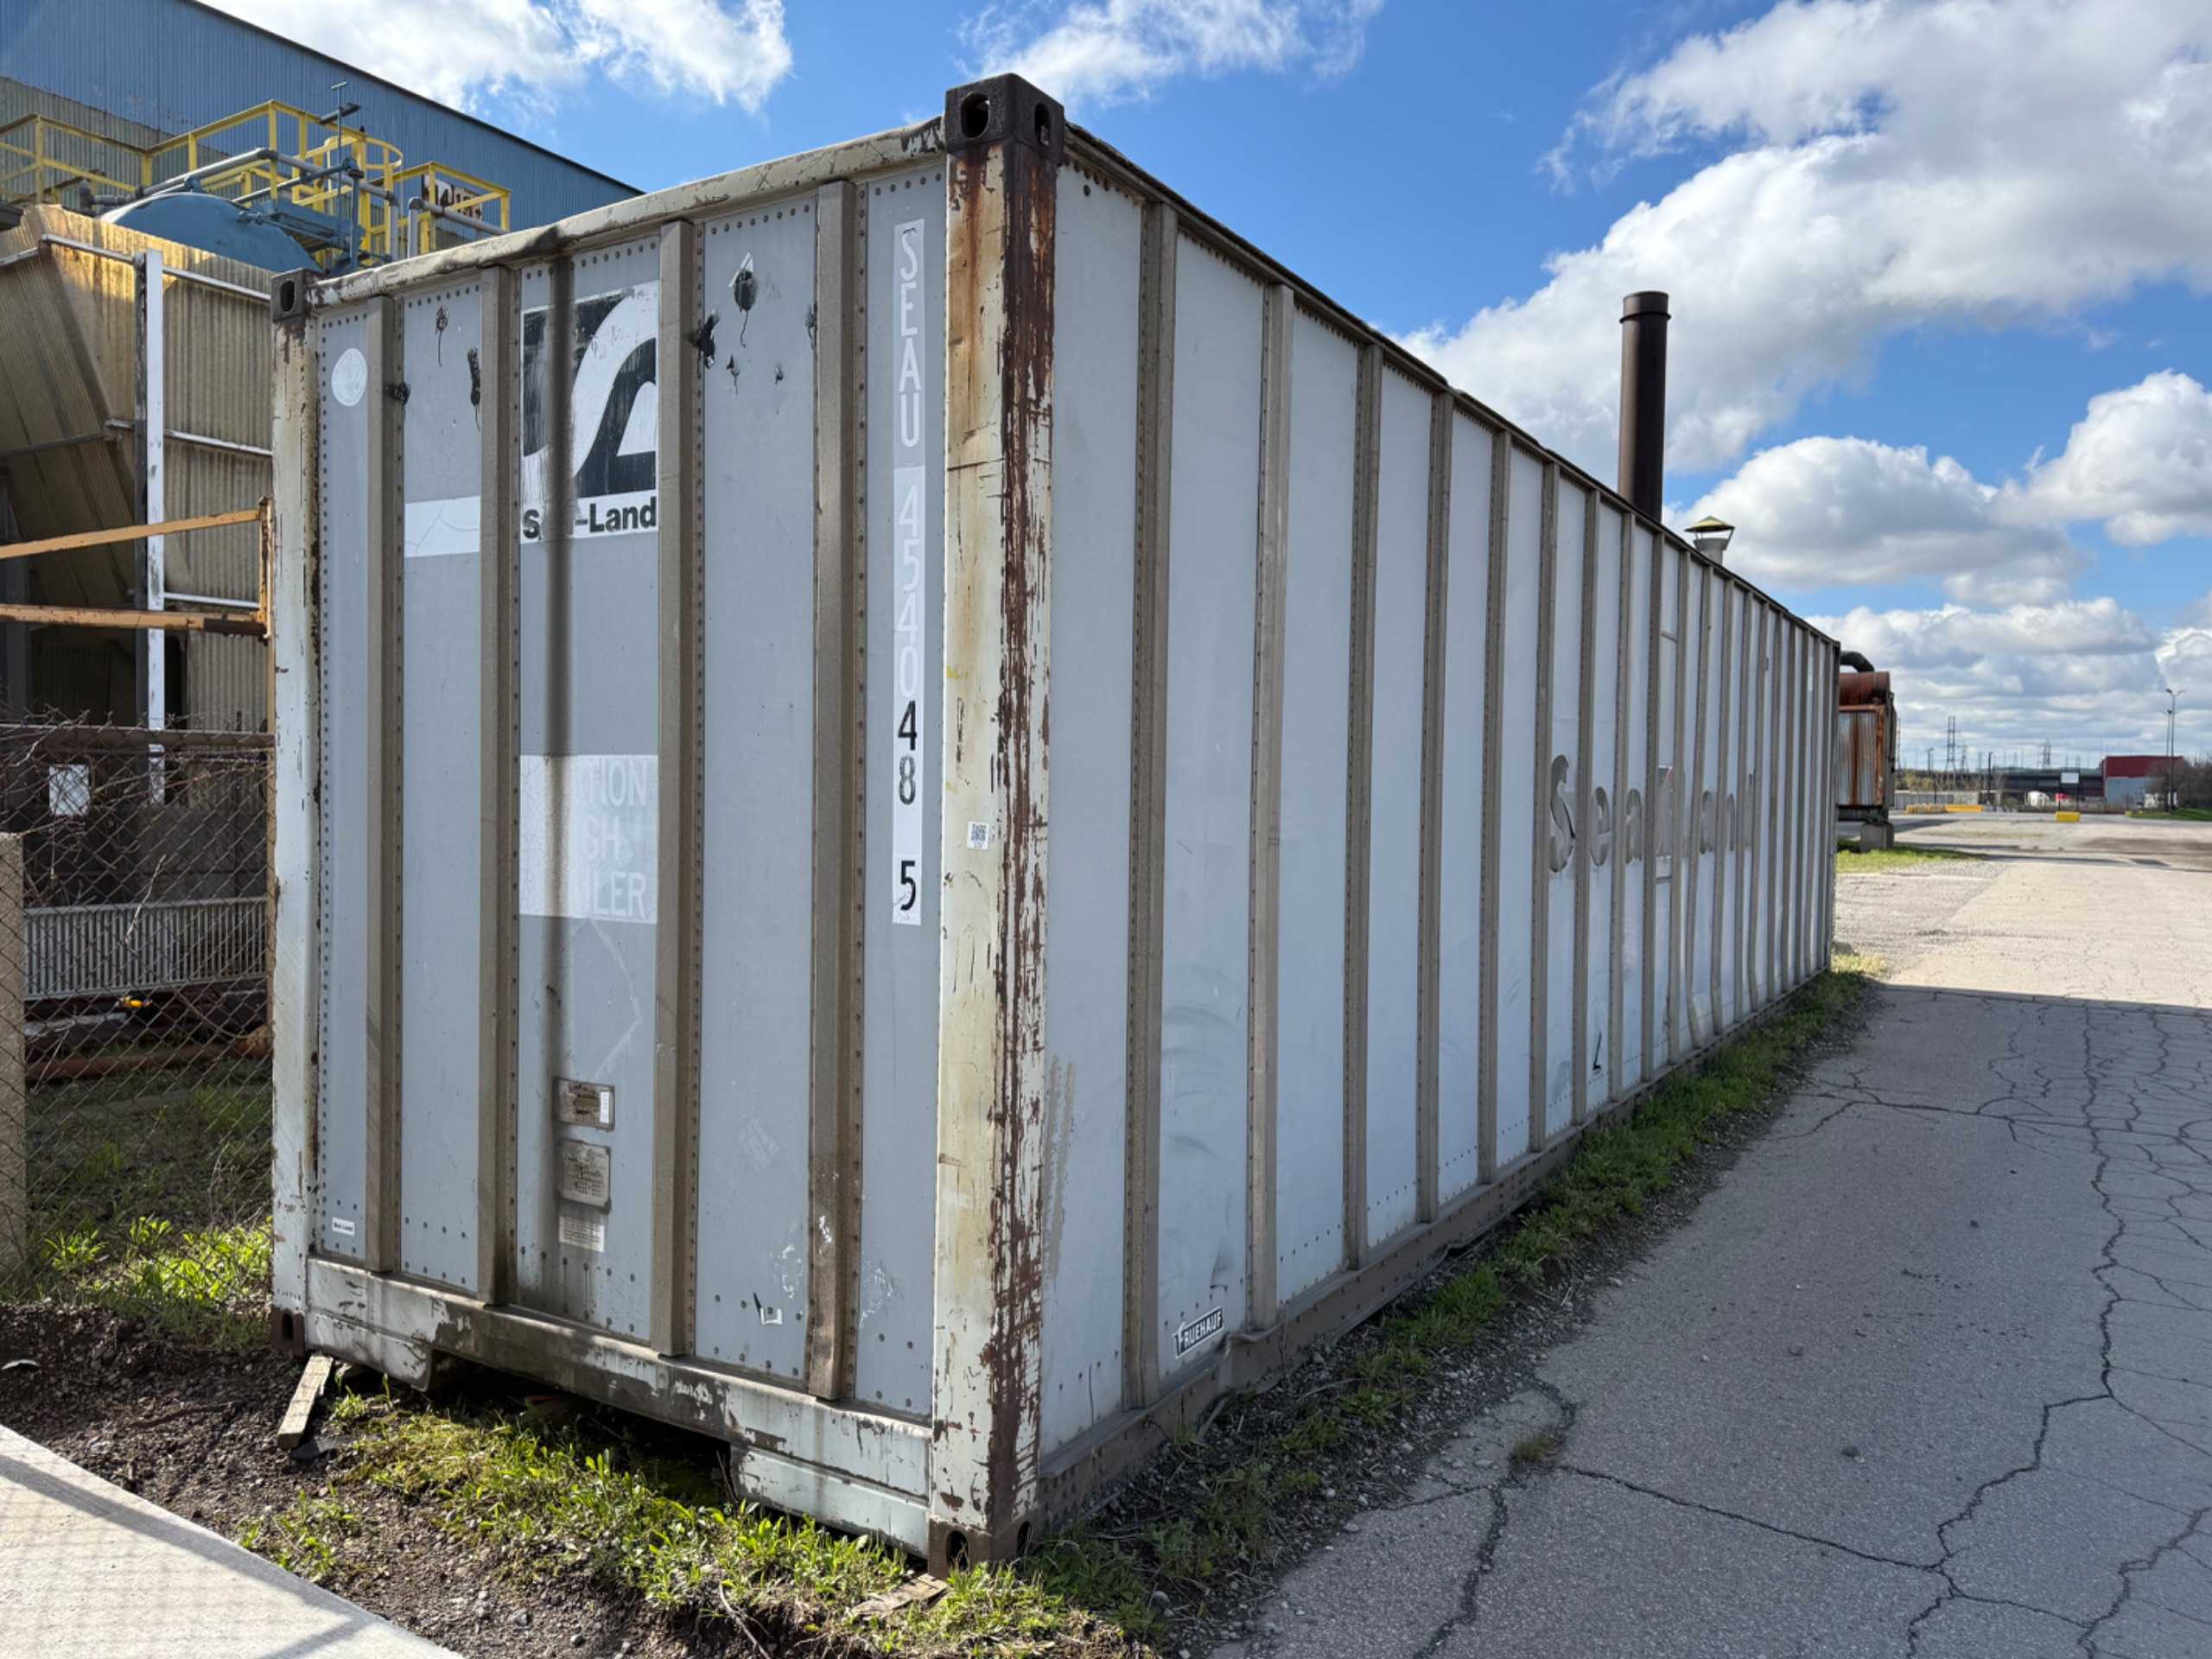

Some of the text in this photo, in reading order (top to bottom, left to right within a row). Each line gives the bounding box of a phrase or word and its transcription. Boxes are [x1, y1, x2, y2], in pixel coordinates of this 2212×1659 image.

[899, 227, 922, 448] SEAU
[523, 496, 658, 539] S-Land
[1172, 1310, 1223, 1356] FRUEHAUF
